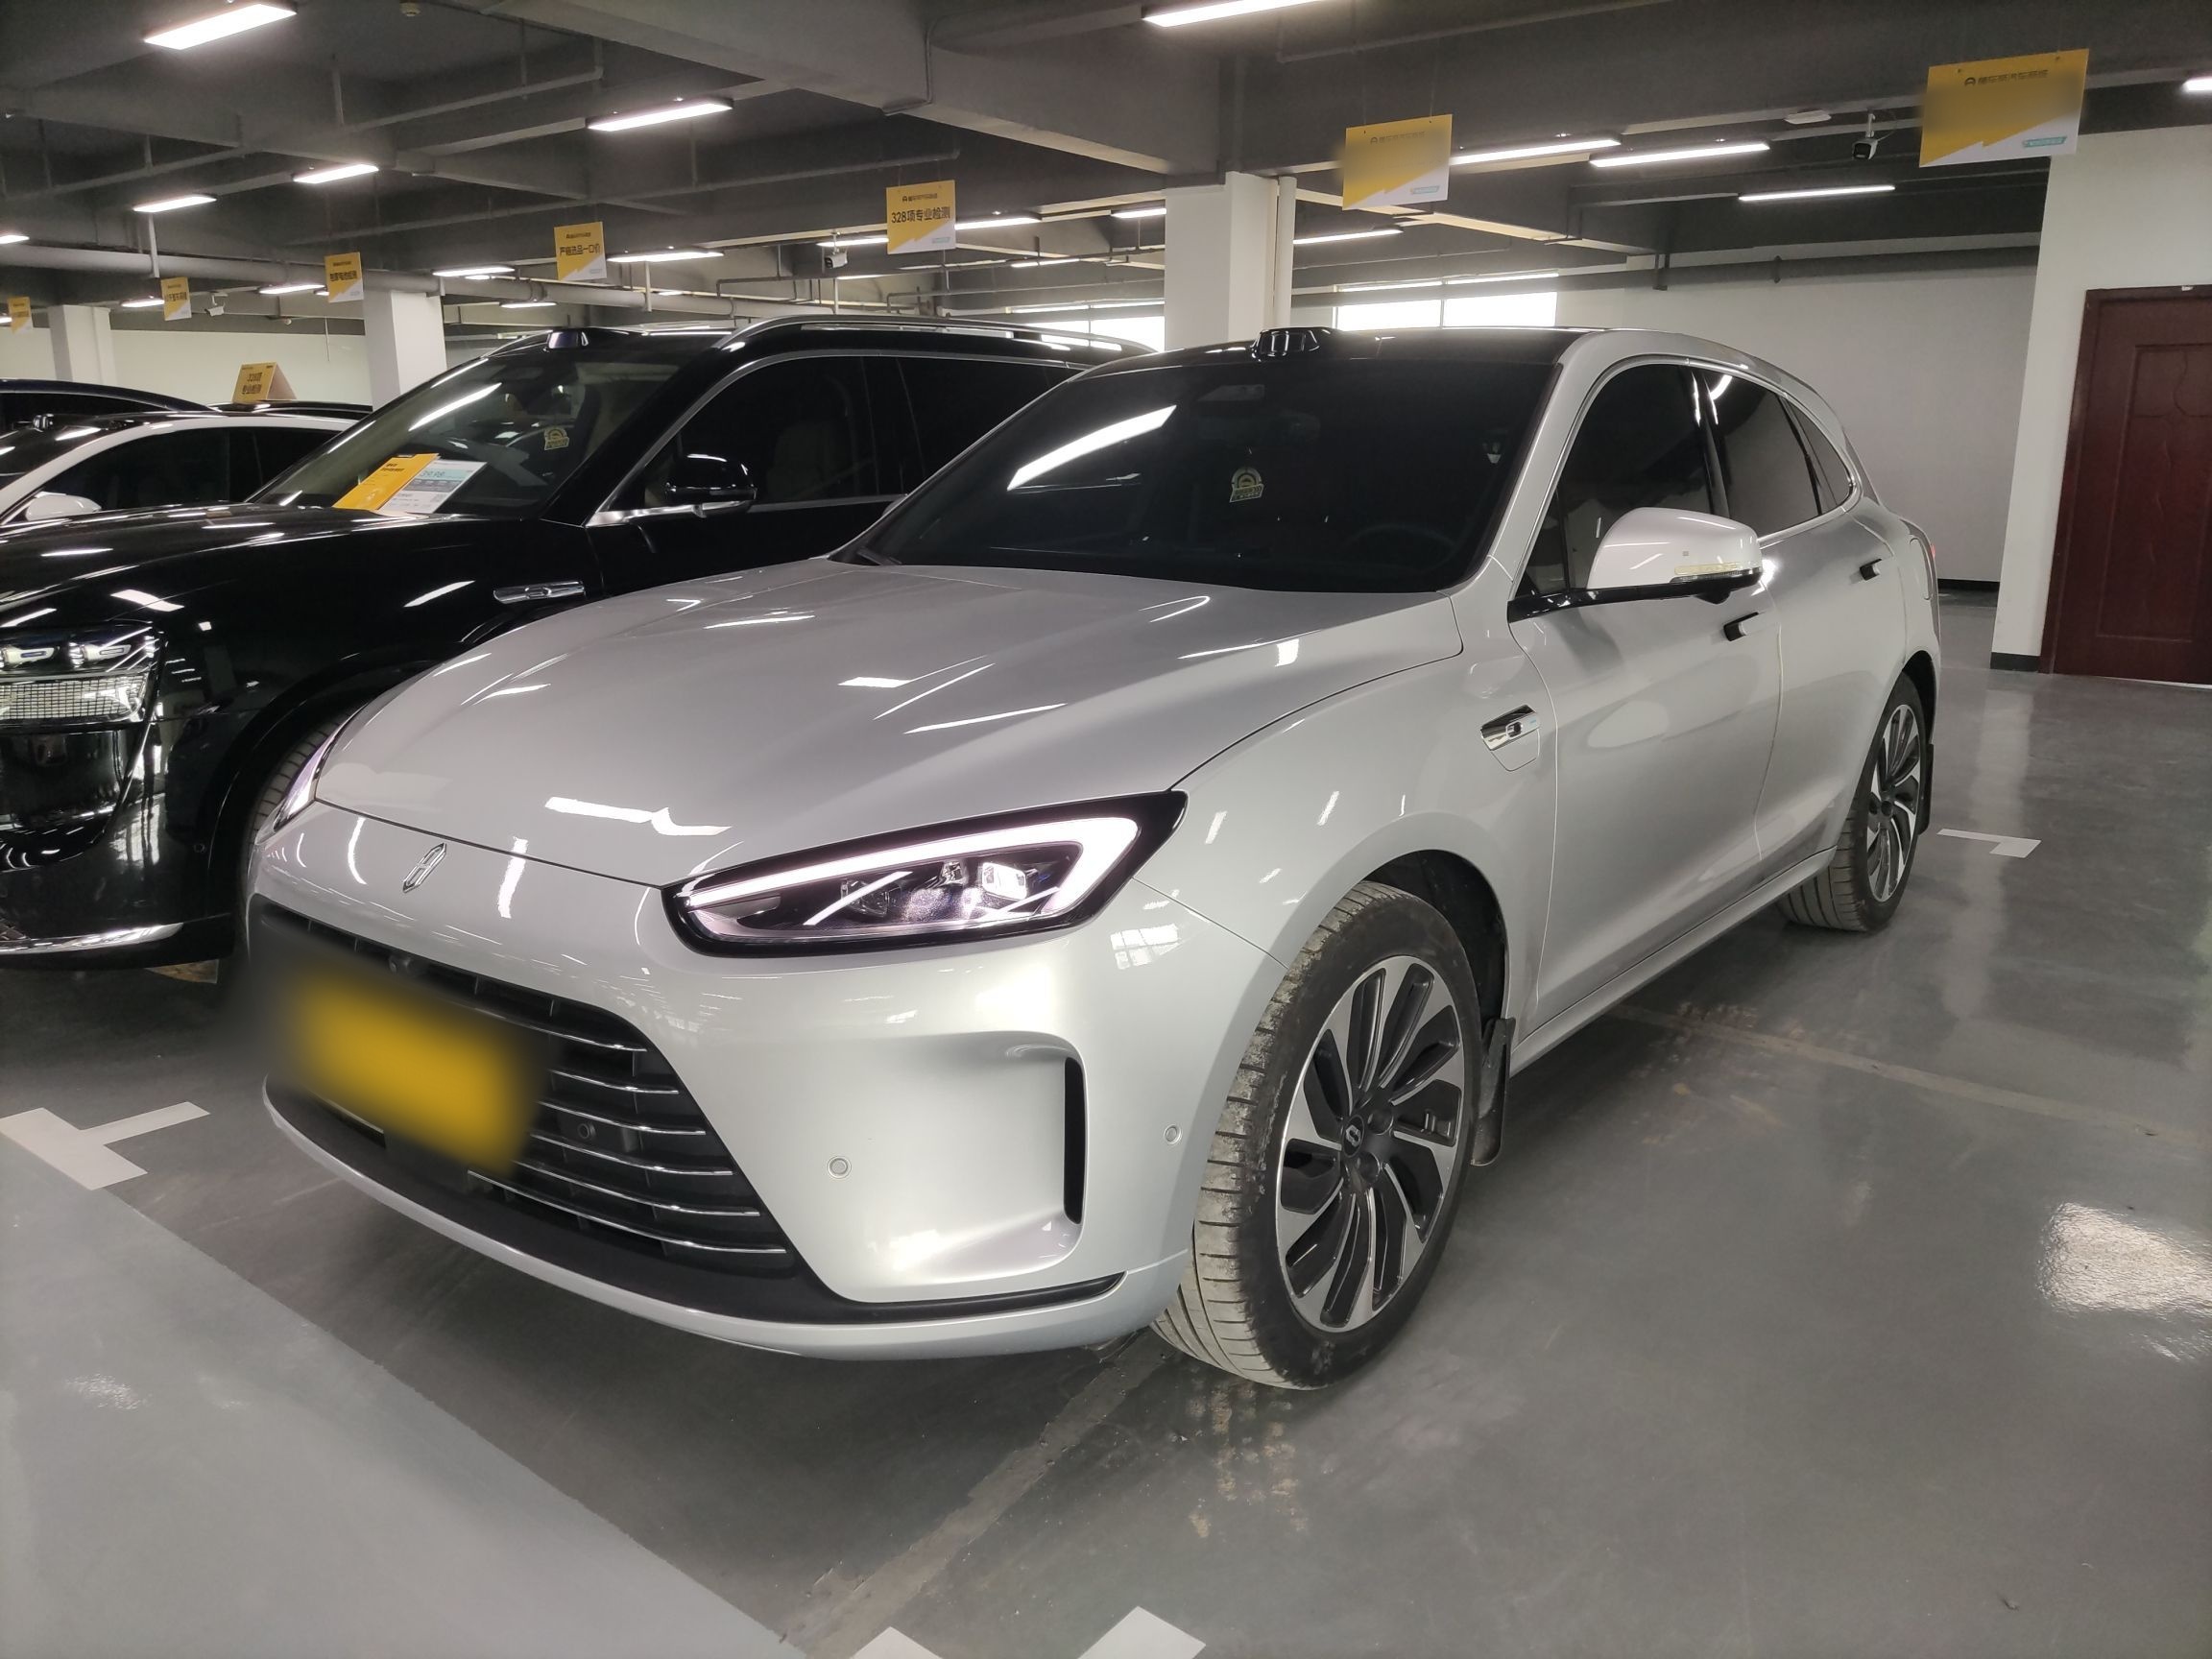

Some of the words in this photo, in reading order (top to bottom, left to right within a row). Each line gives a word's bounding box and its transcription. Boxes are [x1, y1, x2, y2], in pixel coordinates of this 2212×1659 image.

[891, 206, 950, 223] 328项专业检测
